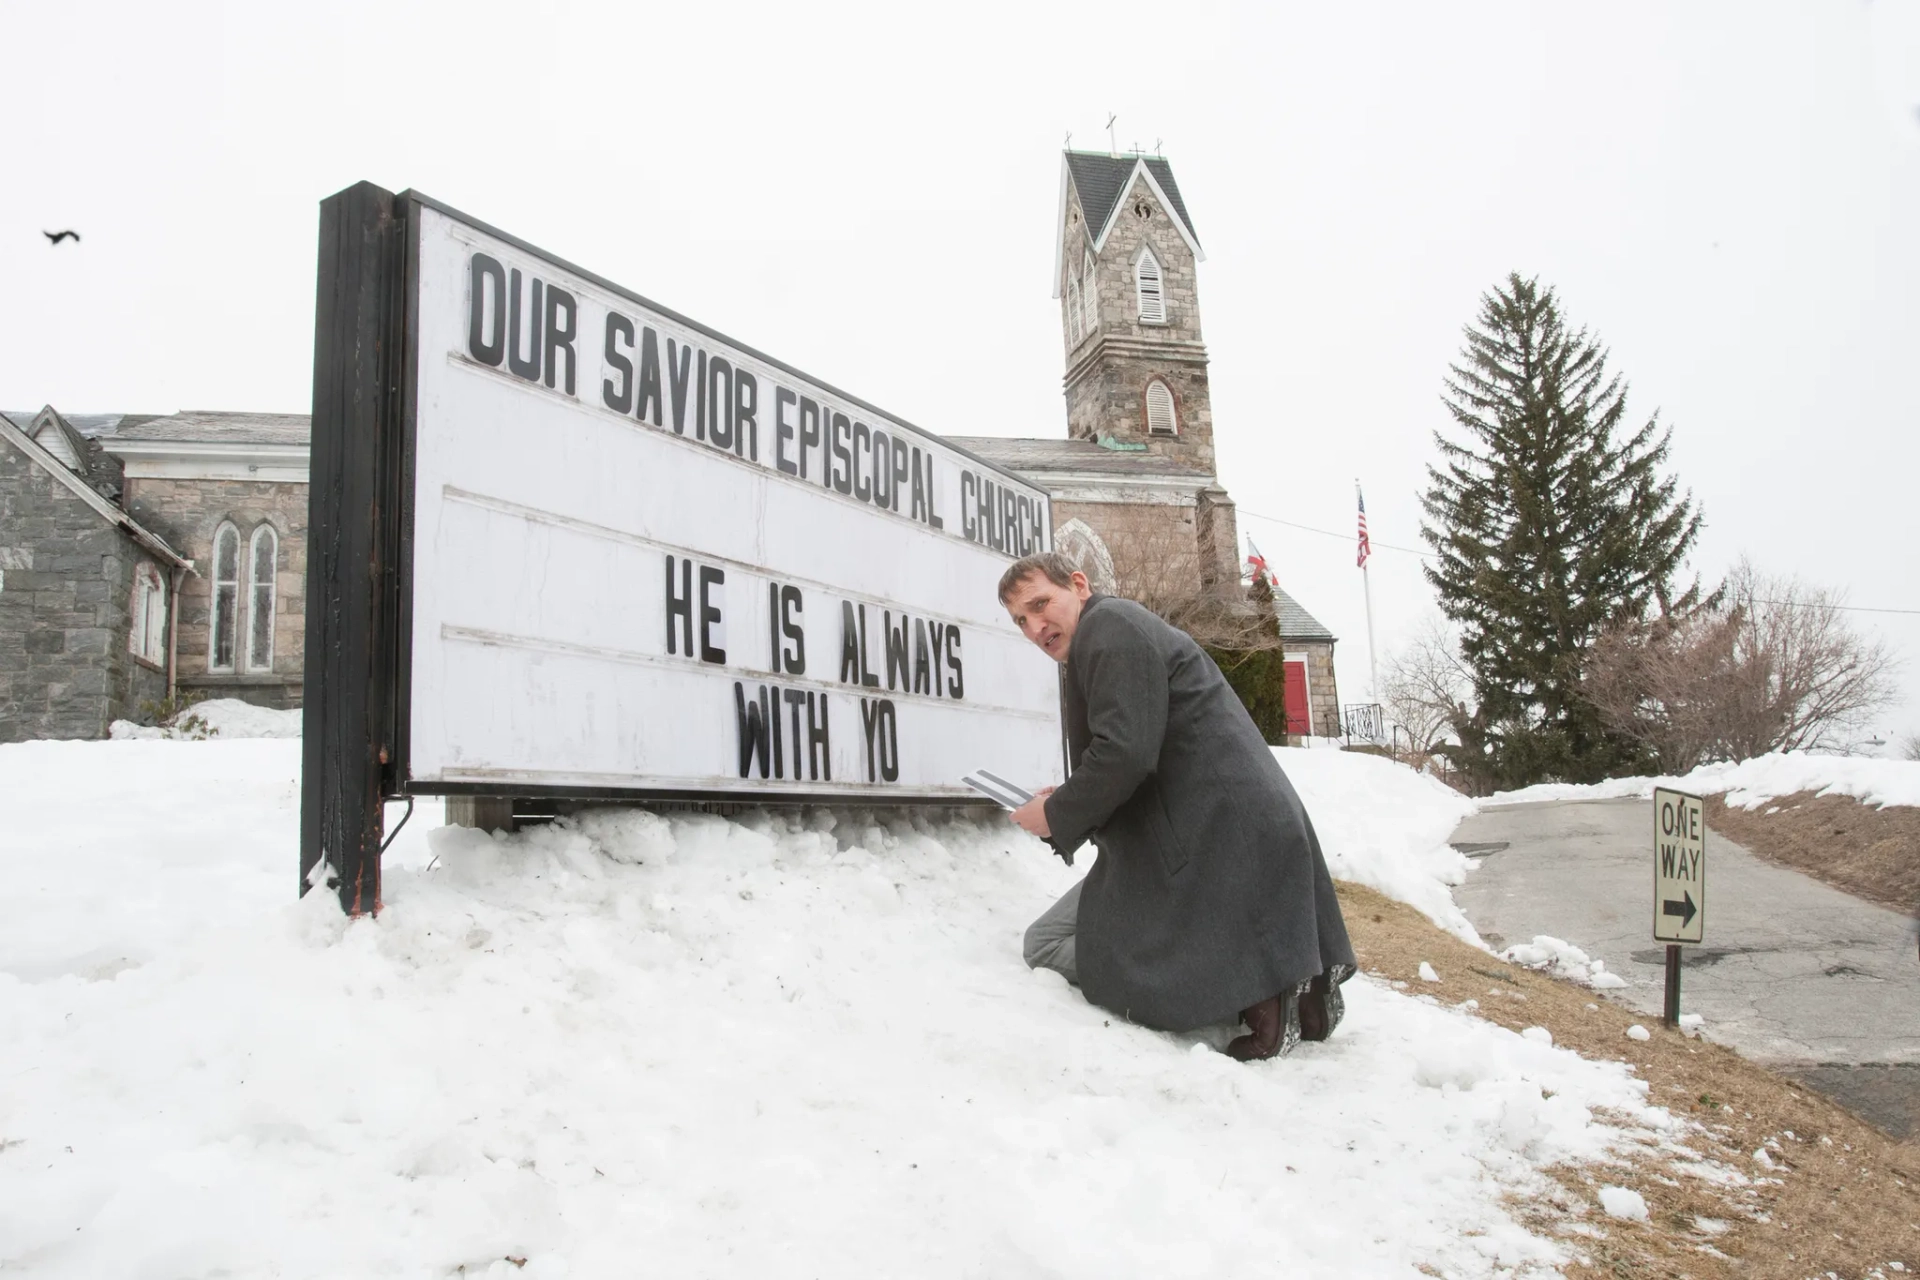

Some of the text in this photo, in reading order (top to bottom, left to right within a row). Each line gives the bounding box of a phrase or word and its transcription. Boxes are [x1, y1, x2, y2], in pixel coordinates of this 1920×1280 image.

[468, 252, 1044, 558] OUR SAVIOR EPISCOPAL CHURCH
[666, 555, 965, 700] HE IS ALWAYS
[734, 682, 899, 783] WITH YO
[1661, 844, 1700, 882] WAY
[1662, 802, 1699, 841] ONE
